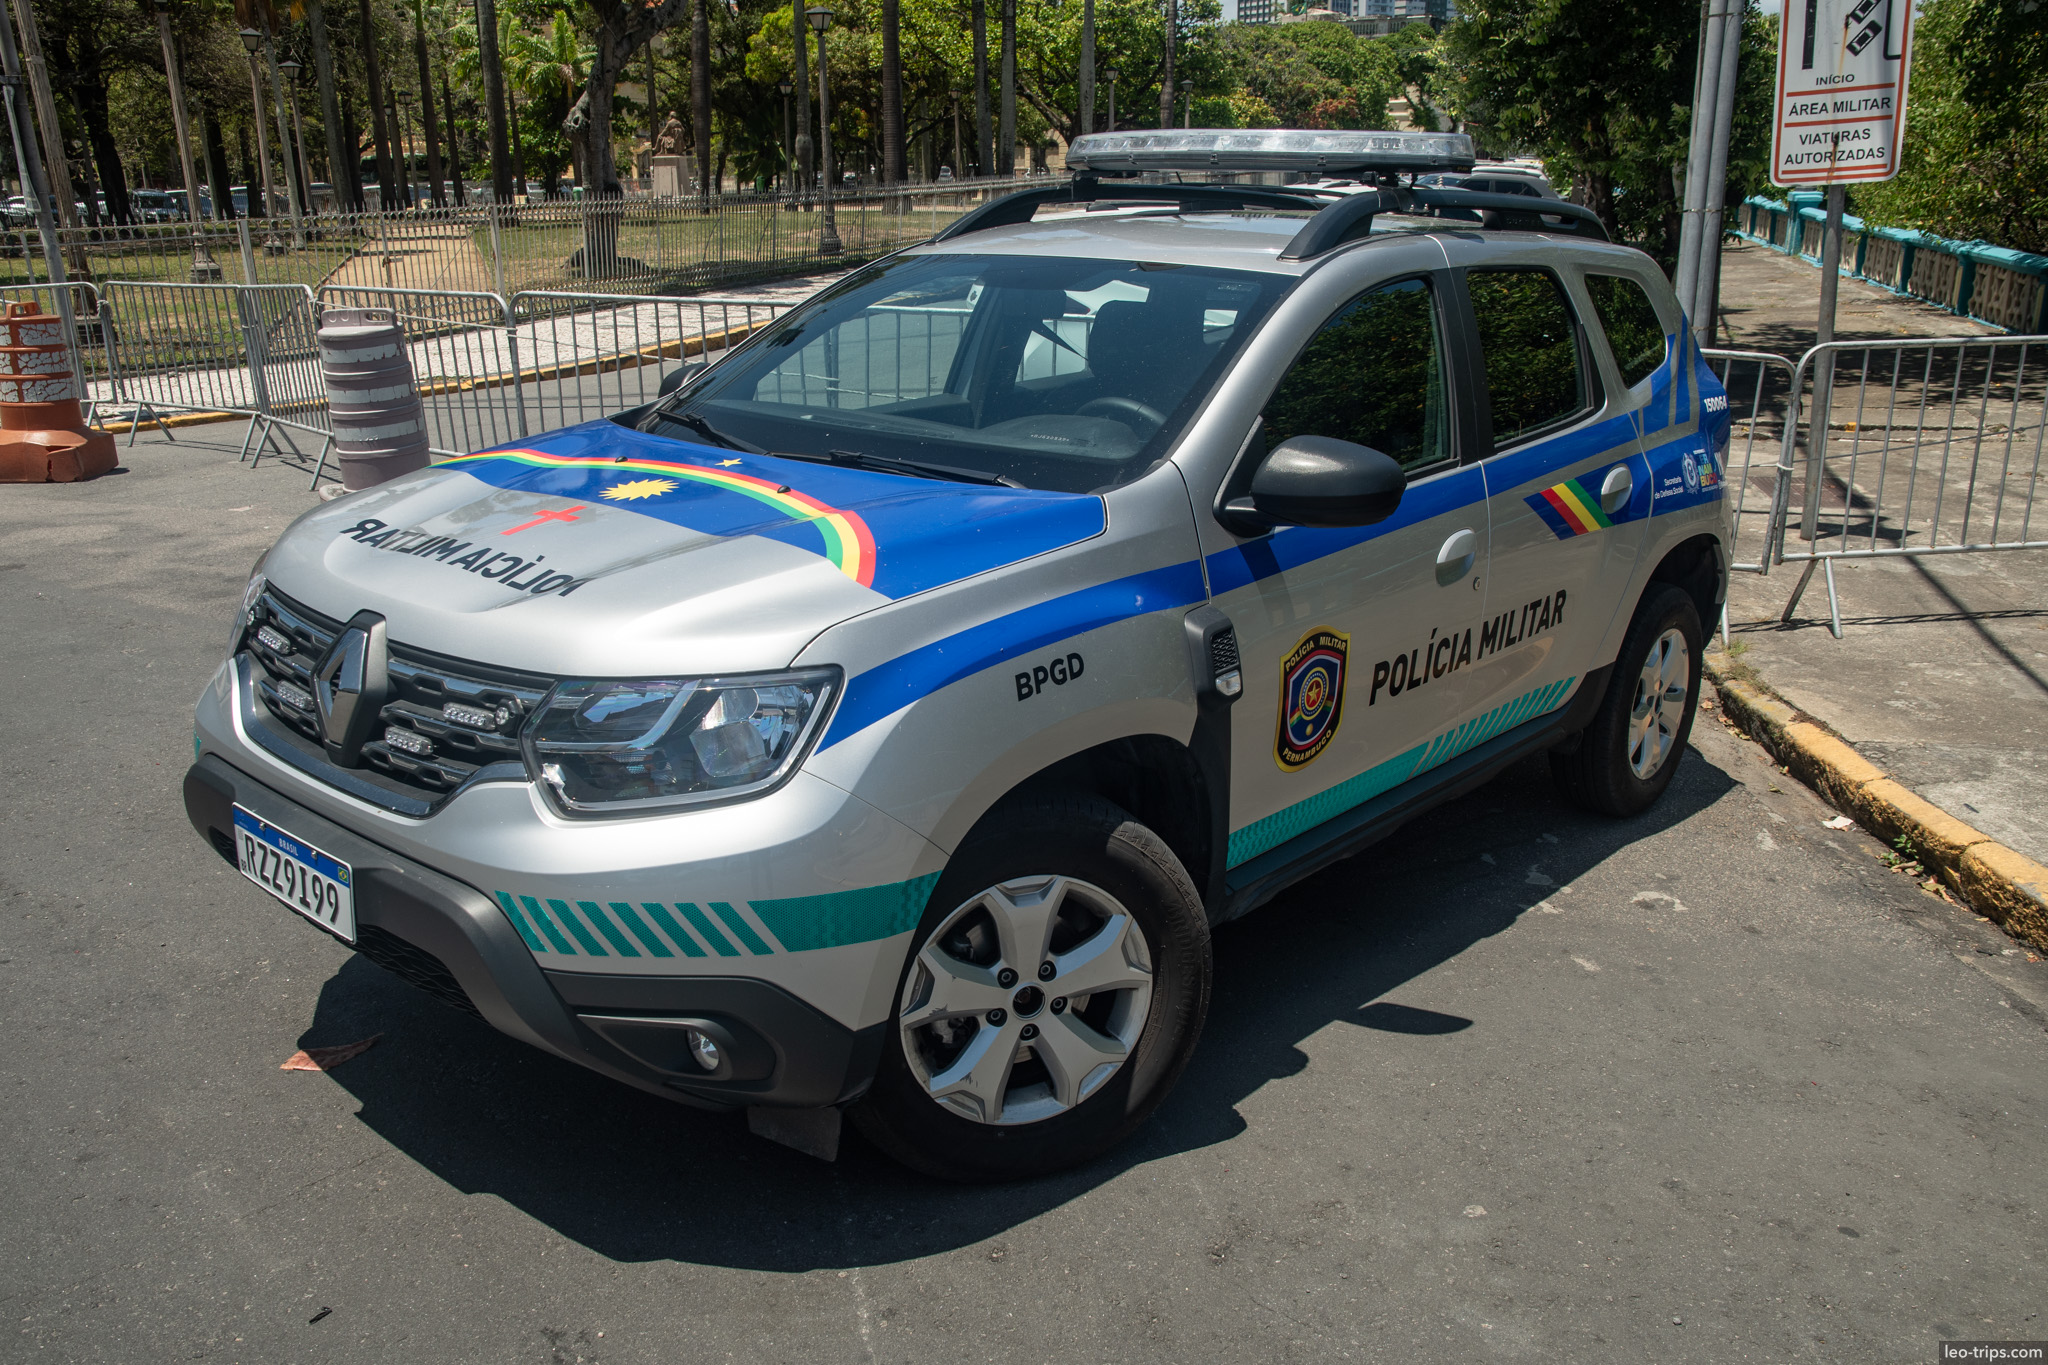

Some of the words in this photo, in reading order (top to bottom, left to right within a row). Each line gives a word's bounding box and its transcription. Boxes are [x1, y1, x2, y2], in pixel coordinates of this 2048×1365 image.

[1815, 74, 1855, 86] INÍCIO
[1788, 102, 1829, 116] ÁREA
[1833, 97, 1892, 113] MILITAR
[1799, 128, 1871, 145] VIATURAS
[1784, 147, 1886, 165] AUTORIZADAS
[1285, 640, 1314, 672] POLÍCIA
[1320, 636, 1347, 652] MILITAR
[1369, 627, 1471, 707] POLÍCIA
[1477, 589, 1567, 661] MILITAR
[1015, 652, 1085, 702] BPGD
[1282, 729, 1332, 762] PERNAMBUCO
[278, 837, 299, 857] BRASIL
